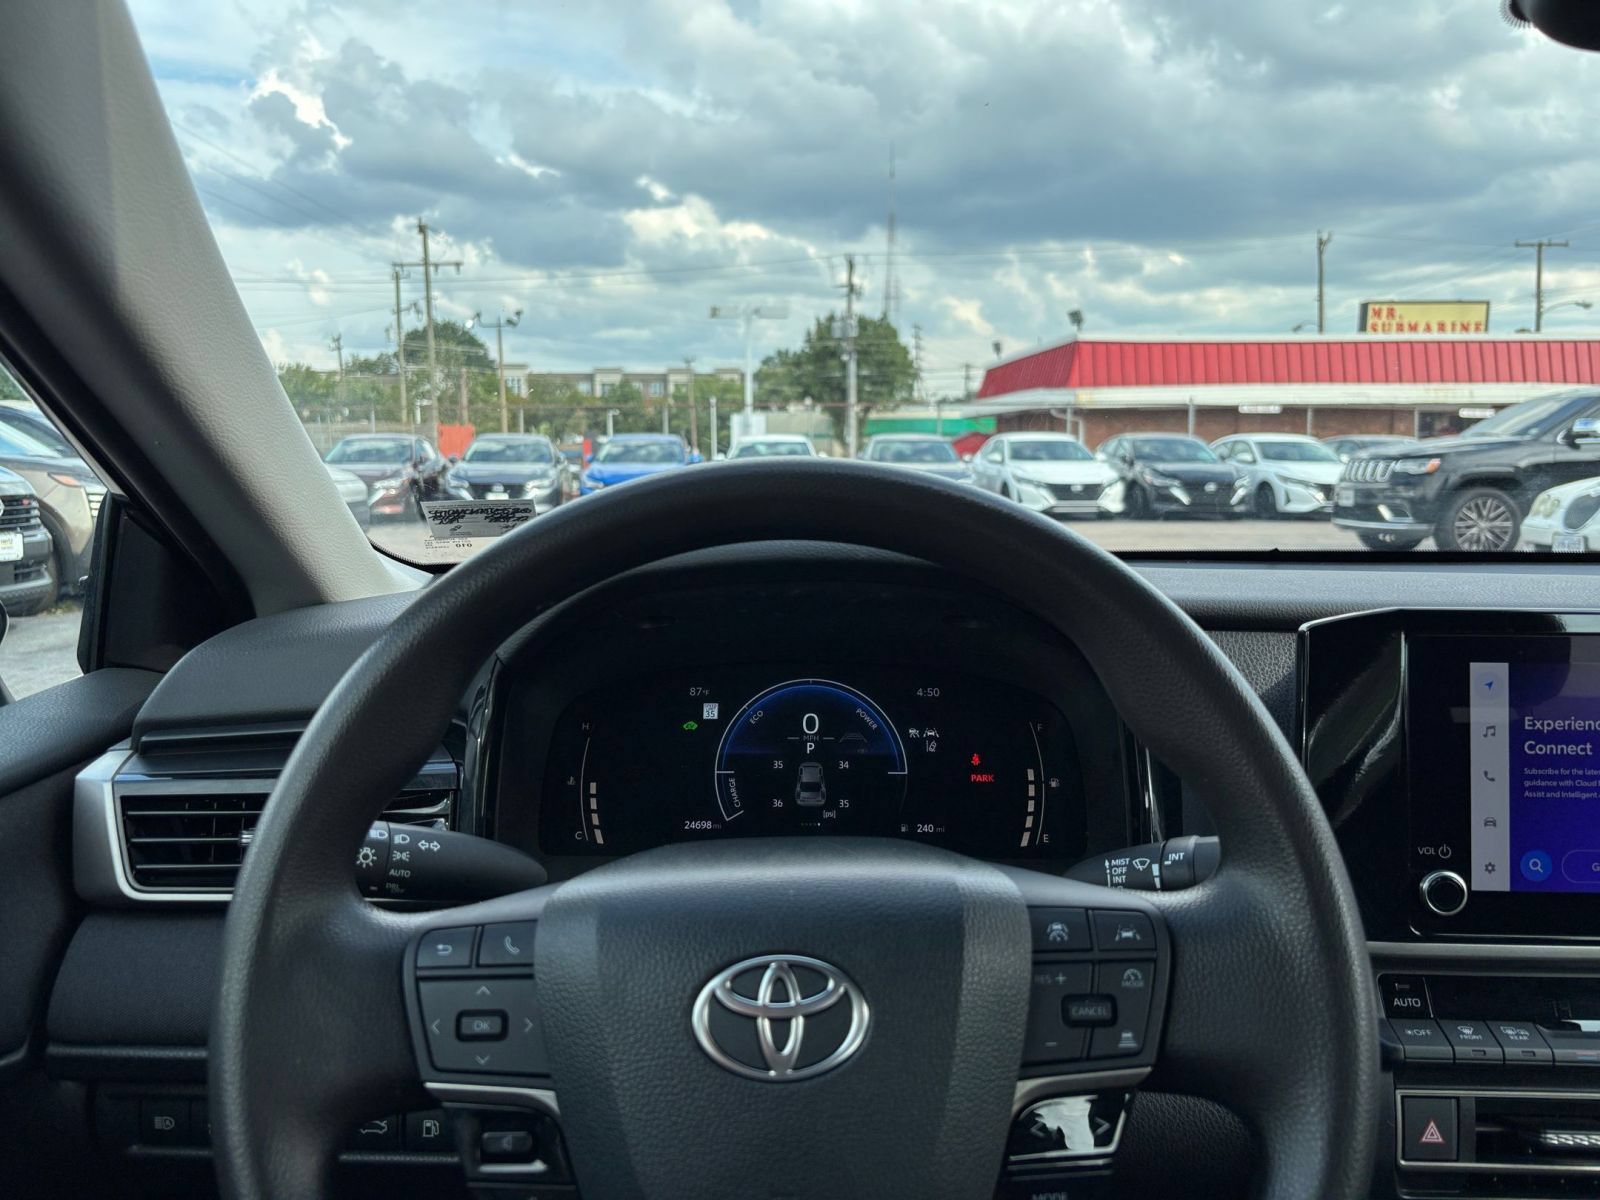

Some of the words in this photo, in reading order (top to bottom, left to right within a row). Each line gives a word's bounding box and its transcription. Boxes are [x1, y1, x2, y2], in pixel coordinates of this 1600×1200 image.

[1371, 305, 1403, 319] MR.
[1370, 321, 1483, 332] SUBMARINE
[916, 688, 940, 697] 4:50
[750, 710, 764, 725] ECO
[855, 707, 878, 730] POWER
[802, 713, 819, 734] 0
[806, 742, 815, 754] P
[1524, 740, 1593, 755] Connect
[773, 761, 783, 769] 35
[838, 761, 849, 769] 34
[1523, 767, 1559, 775] Subscribe
[1560, 767, 1570, 775] for
[1571, 767, 1583, 775] the
[971, 774, 994, 782] PARK
[1523, 779, 1557, 787] guidance
[1575, 779, 1597, 787] Cloud
[728, 777, 741, 807] CHARGE
[1523, 790, 1545, 798] Assist
[1545, 790, 1560, 798] and
[1561, 790, 1597, 800] Intelligent
[684, 820, 712, 830] 24698
[917, 824, 934, 833] 240
[1417, 847, 1436, 855] VOL
[1169, 852, 1185, 861] INT
[1111, 858, 1130, 866] MIST
[389, 868, 411, 878] AUTO
[1111, 867, 1127, 875] OFF
[1393, 997, 1421, 1008] AUTO
[473, 1020, 490, 1030] OK
[1413, 1028, 1432, 1036] OFF
